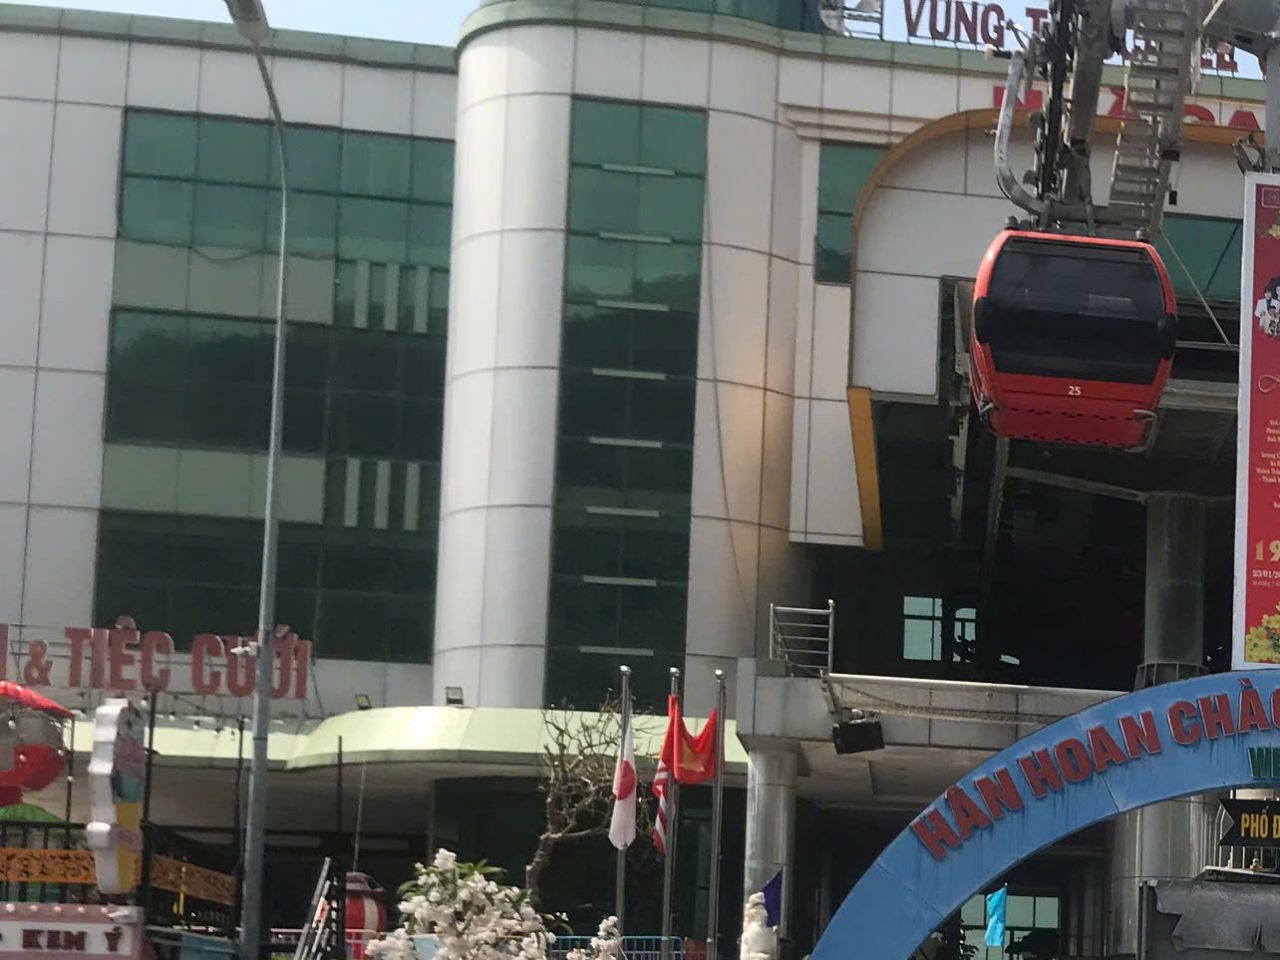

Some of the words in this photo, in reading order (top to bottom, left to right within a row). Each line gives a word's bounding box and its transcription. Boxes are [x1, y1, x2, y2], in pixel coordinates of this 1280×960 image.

[1068, 385, 1082, 397] 25
[24, 640, 53, 687] &
[910, 767, 1024, 861] HÂN
[1018, 710, 1162, 799] HOAN
[22, 929, 85, 950] KEM
